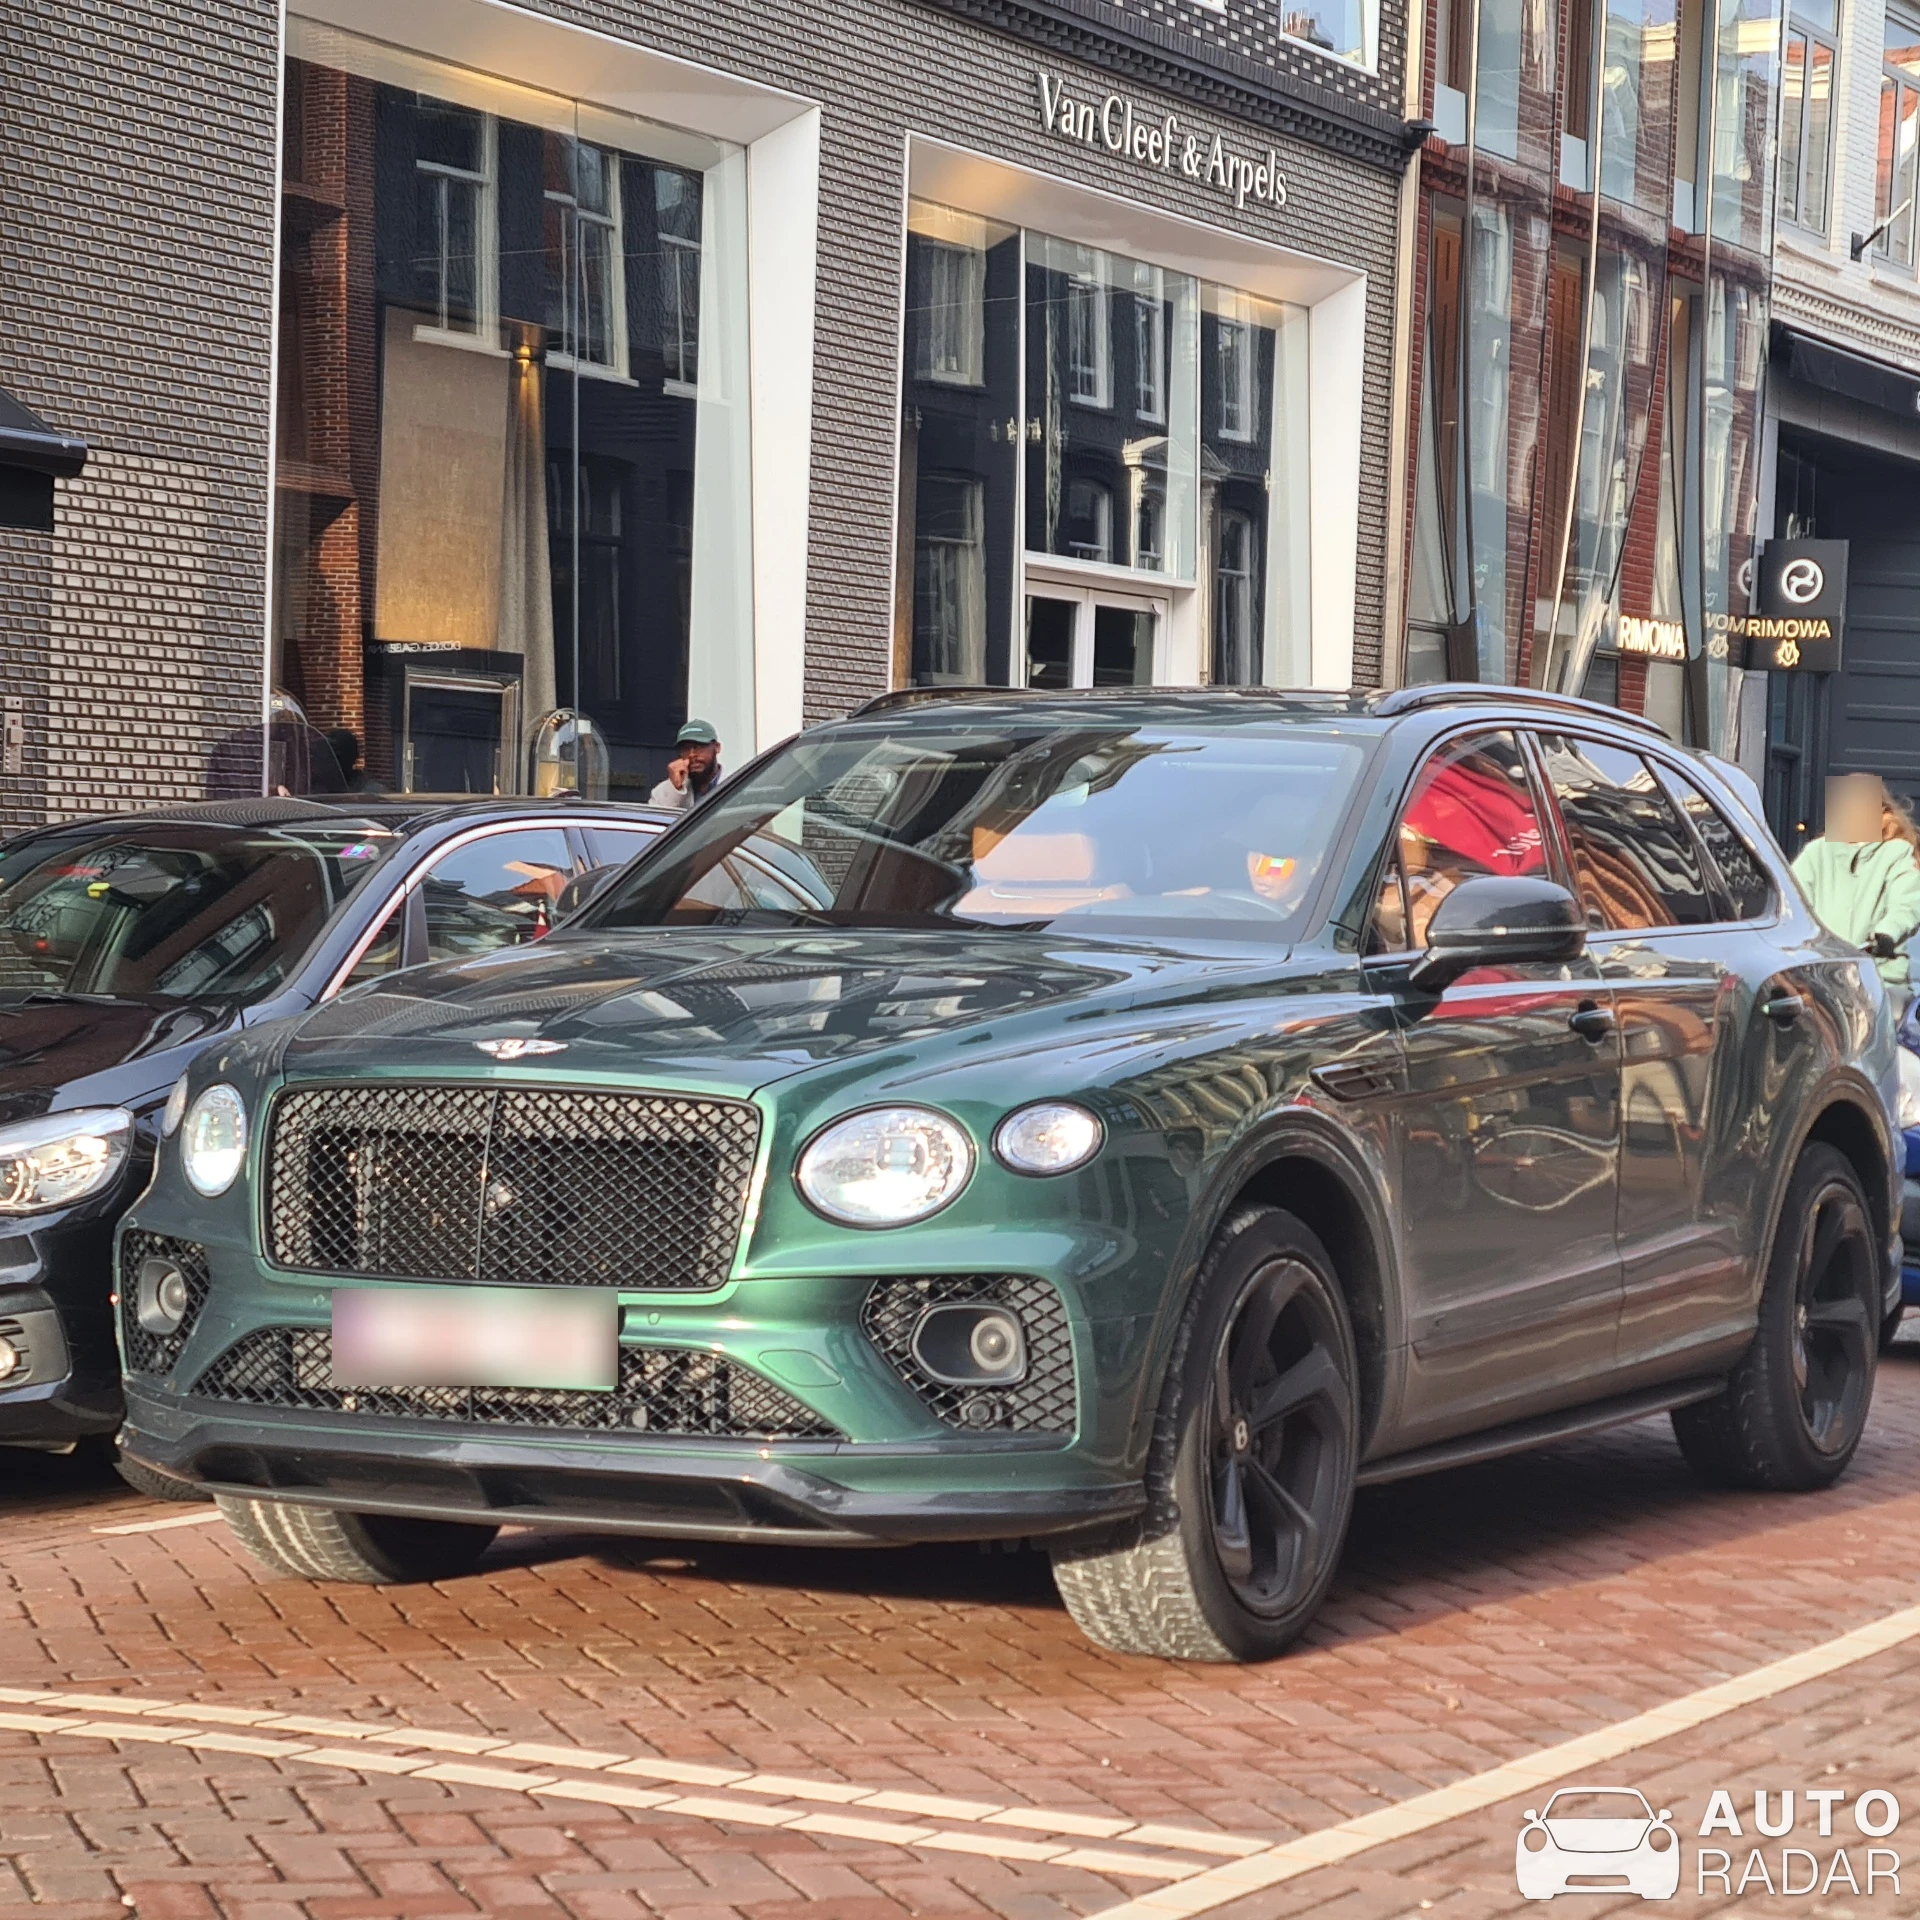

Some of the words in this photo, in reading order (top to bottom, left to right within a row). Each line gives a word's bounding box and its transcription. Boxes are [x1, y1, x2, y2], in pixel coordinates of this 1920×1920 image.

[1038, 72, 1094, 143] Van
[1103, 95, 1178, 168] Cleef
[1183, 134, 1203, 178] &
[1206, 133, 1288, 209] Arpels
[1617, 615, 1686, 659] RIMOWA
[1746, 619, 1831, 638] RIMOWA
